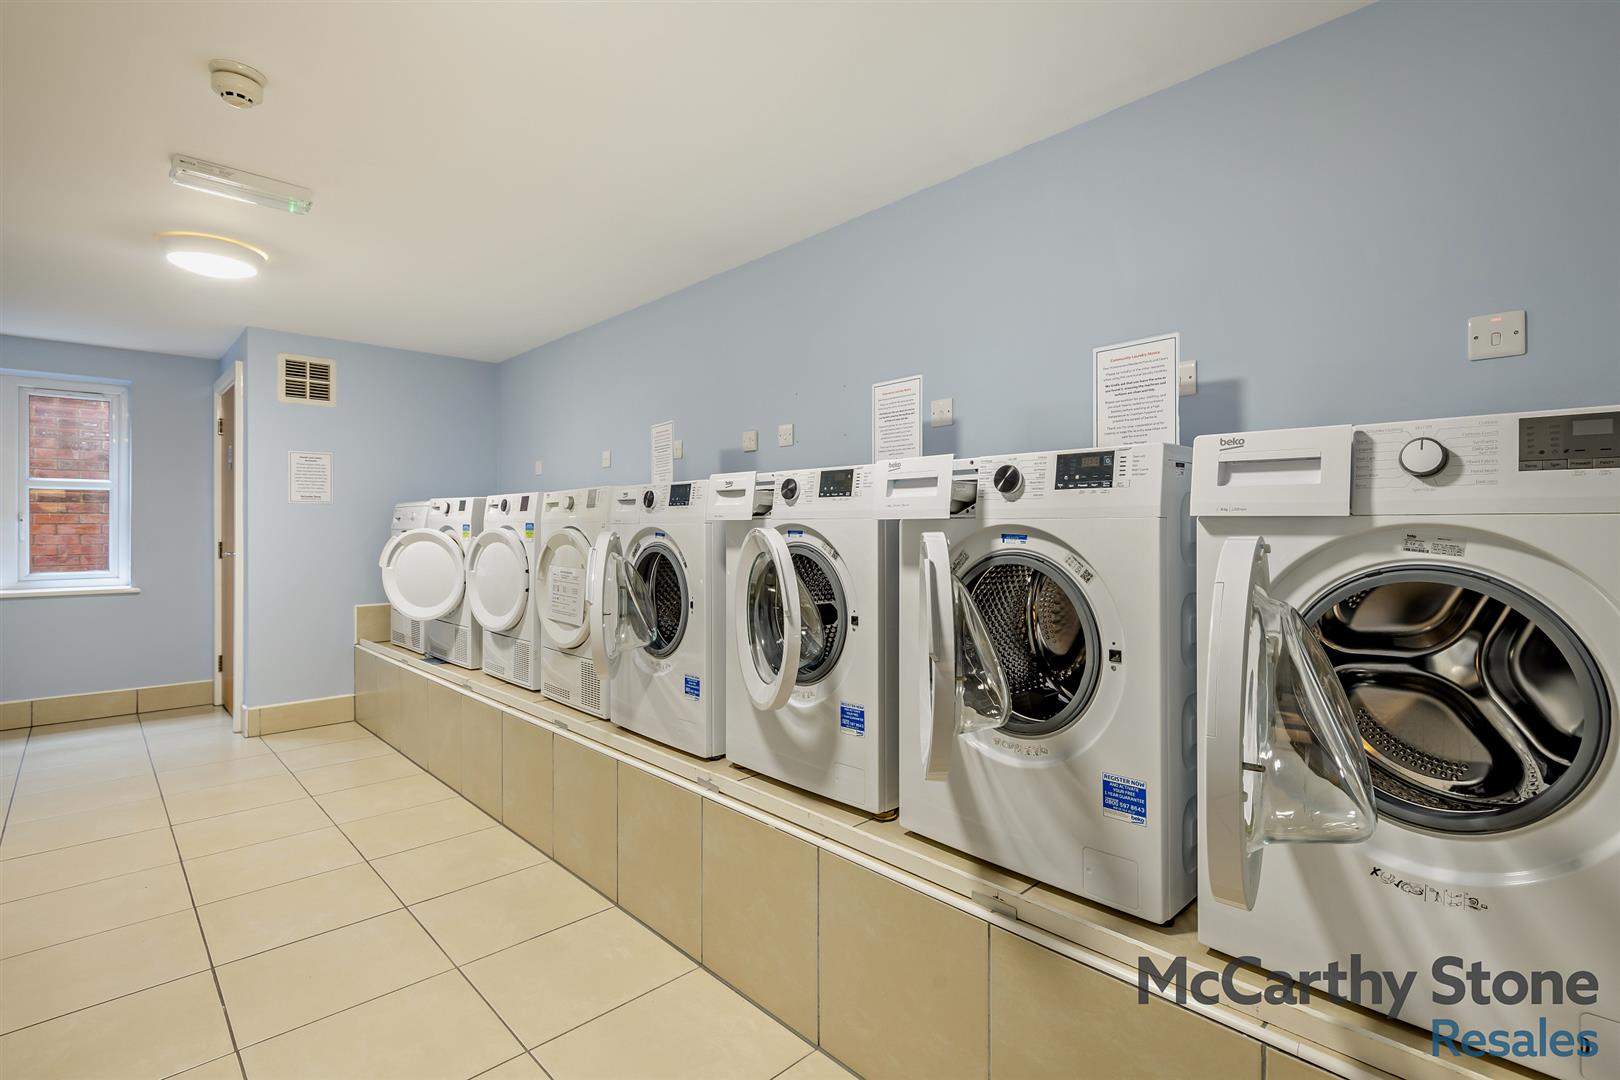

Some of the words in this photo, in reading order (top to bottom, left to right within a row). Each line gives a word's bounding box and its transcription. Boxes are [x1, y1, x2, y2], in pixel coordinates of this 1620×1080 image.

[1220, 437, 1246, 446] beko
[1104, 774, 1130, 783] REGISTER
[1131, 780, 1145, 788] NOW
